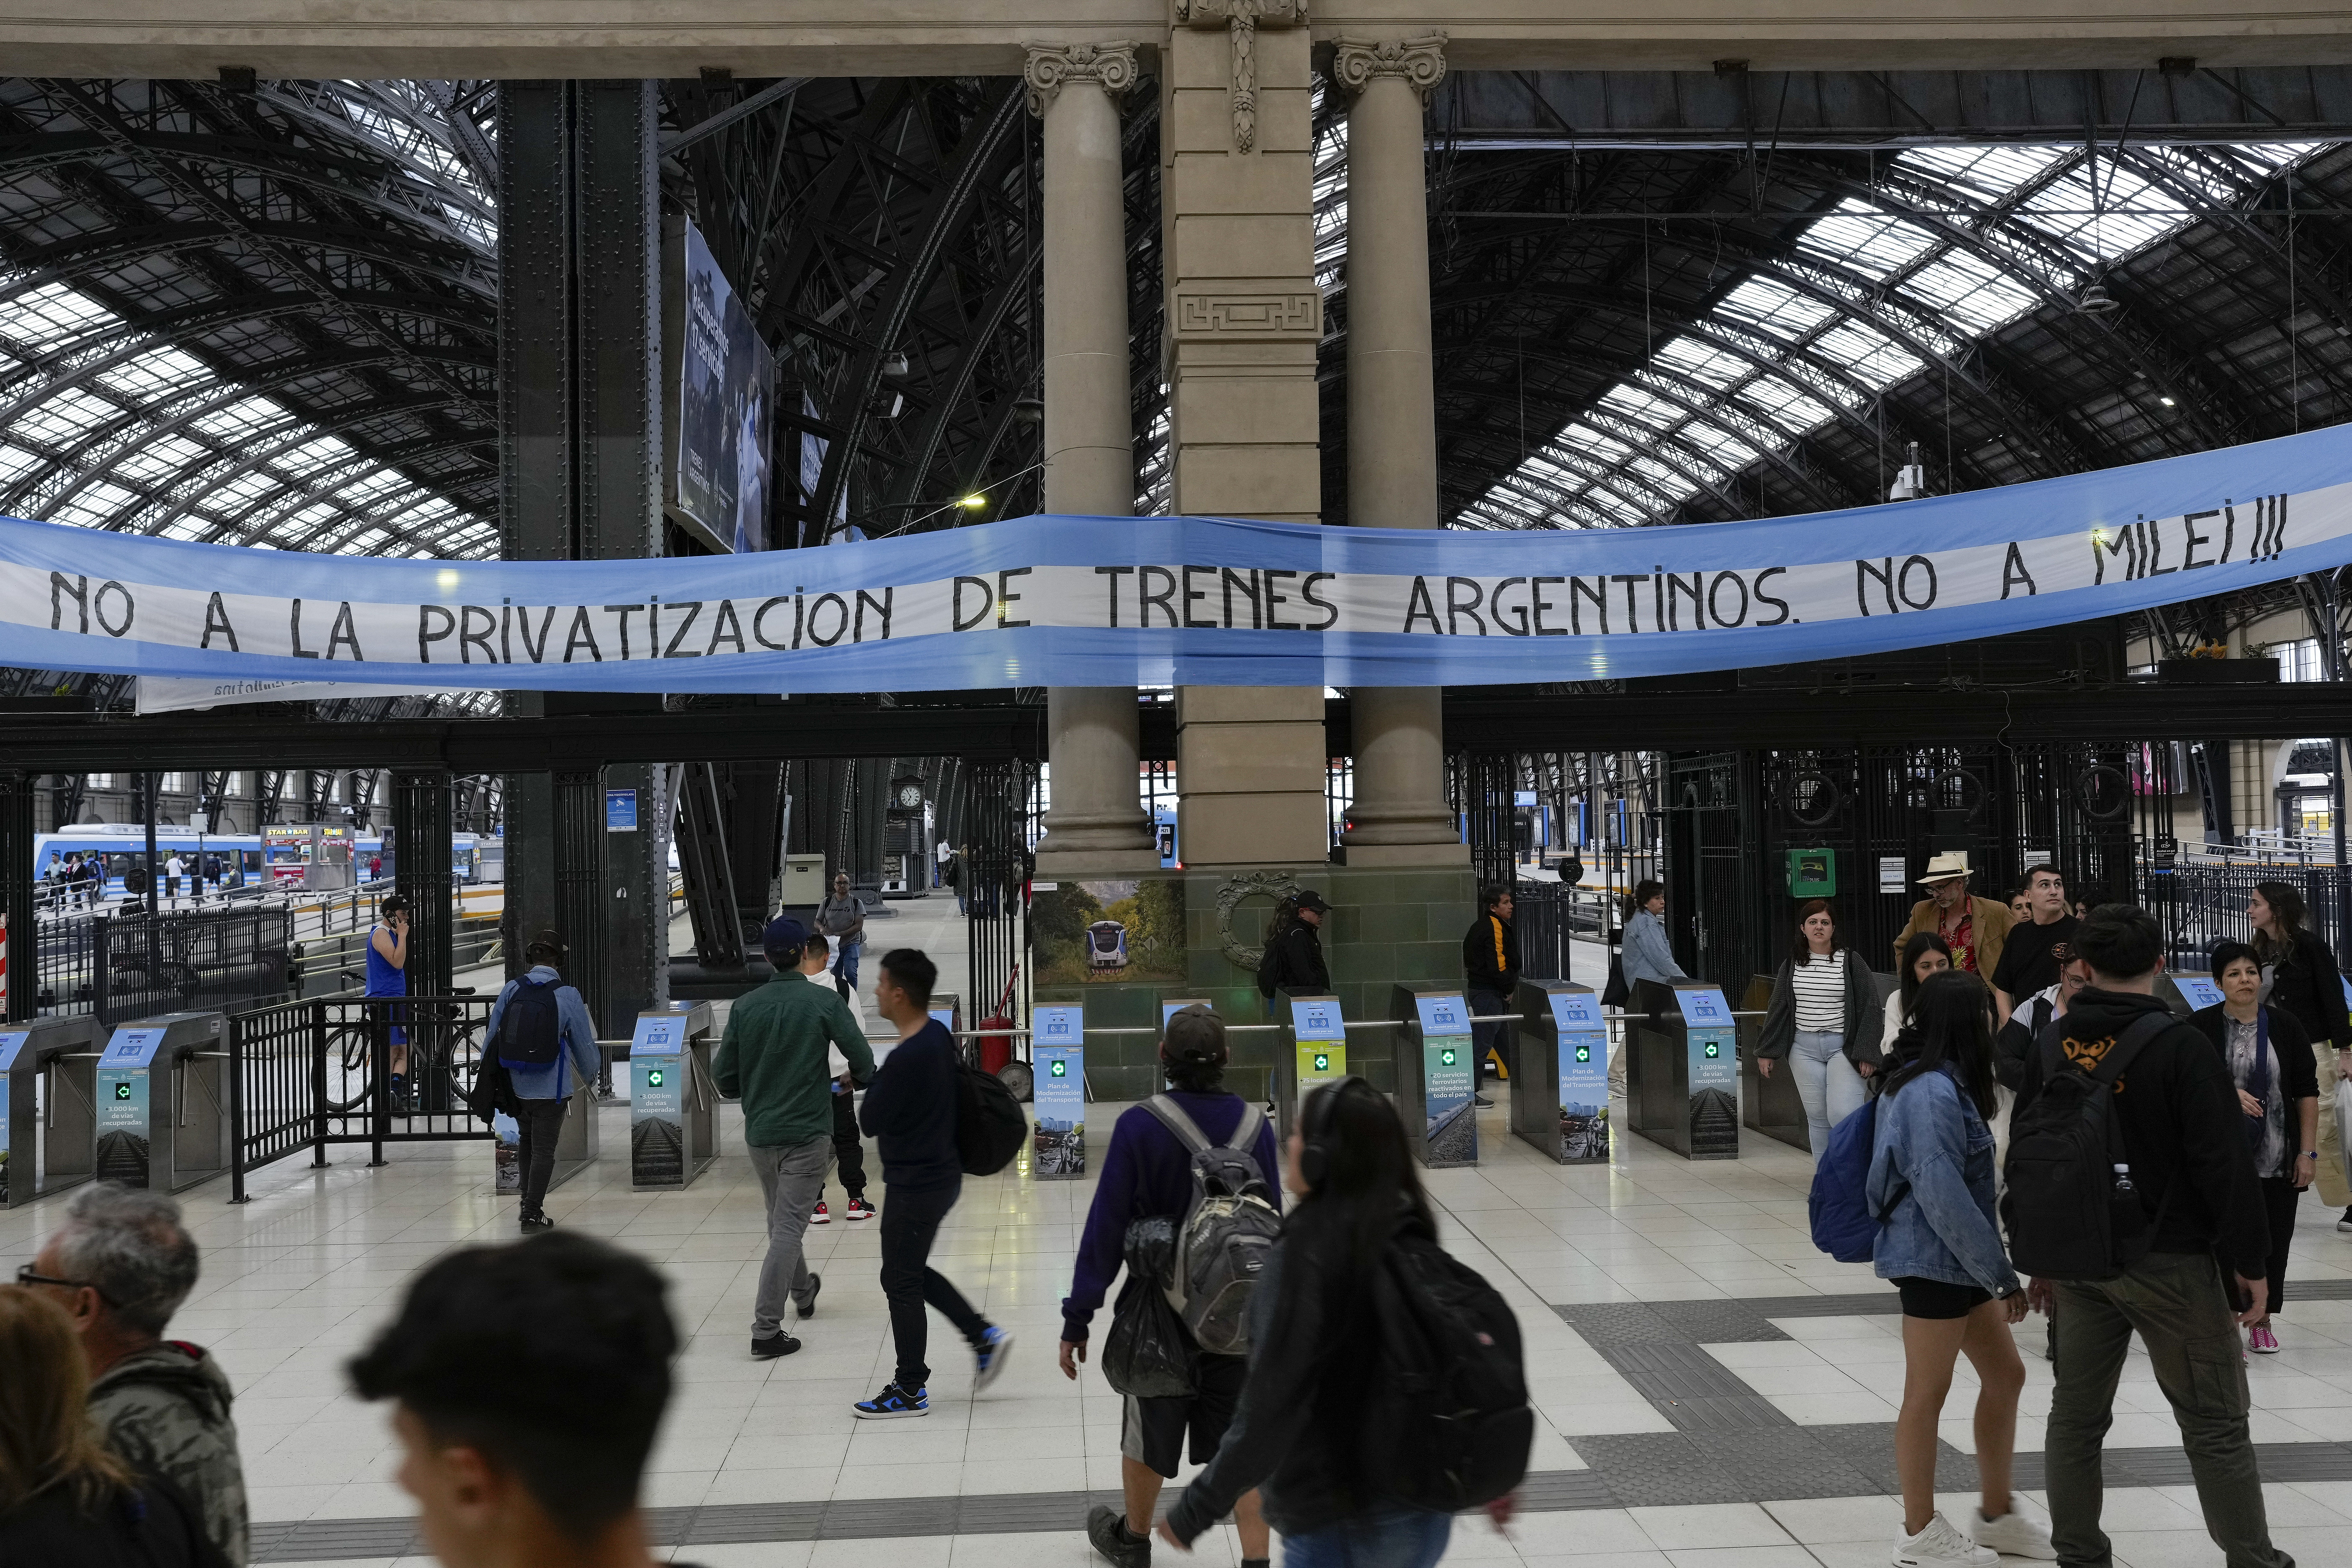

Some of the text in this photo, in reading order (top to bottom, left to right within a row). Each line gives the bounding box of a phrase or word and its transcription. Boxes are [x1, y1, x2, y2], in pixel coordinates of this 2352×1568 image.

[694, 284, 729, 356] Recuperamos
[692, 321, 722, 383] 17 servicios
[689, 466, 710, 495] ARGENTINOS
[690, 448, 702, 471] TRENES
[51, 571, 134, 637] NO
[201, 592, 239, 652] A
[292, 598, 363, 662] LA
[953, 567, 1032, 632] DE
[1095, 565, 1338, 631] TRENES
[1856, 555, 1937, 616] NO
[2000, 542, 2036, 600] A
